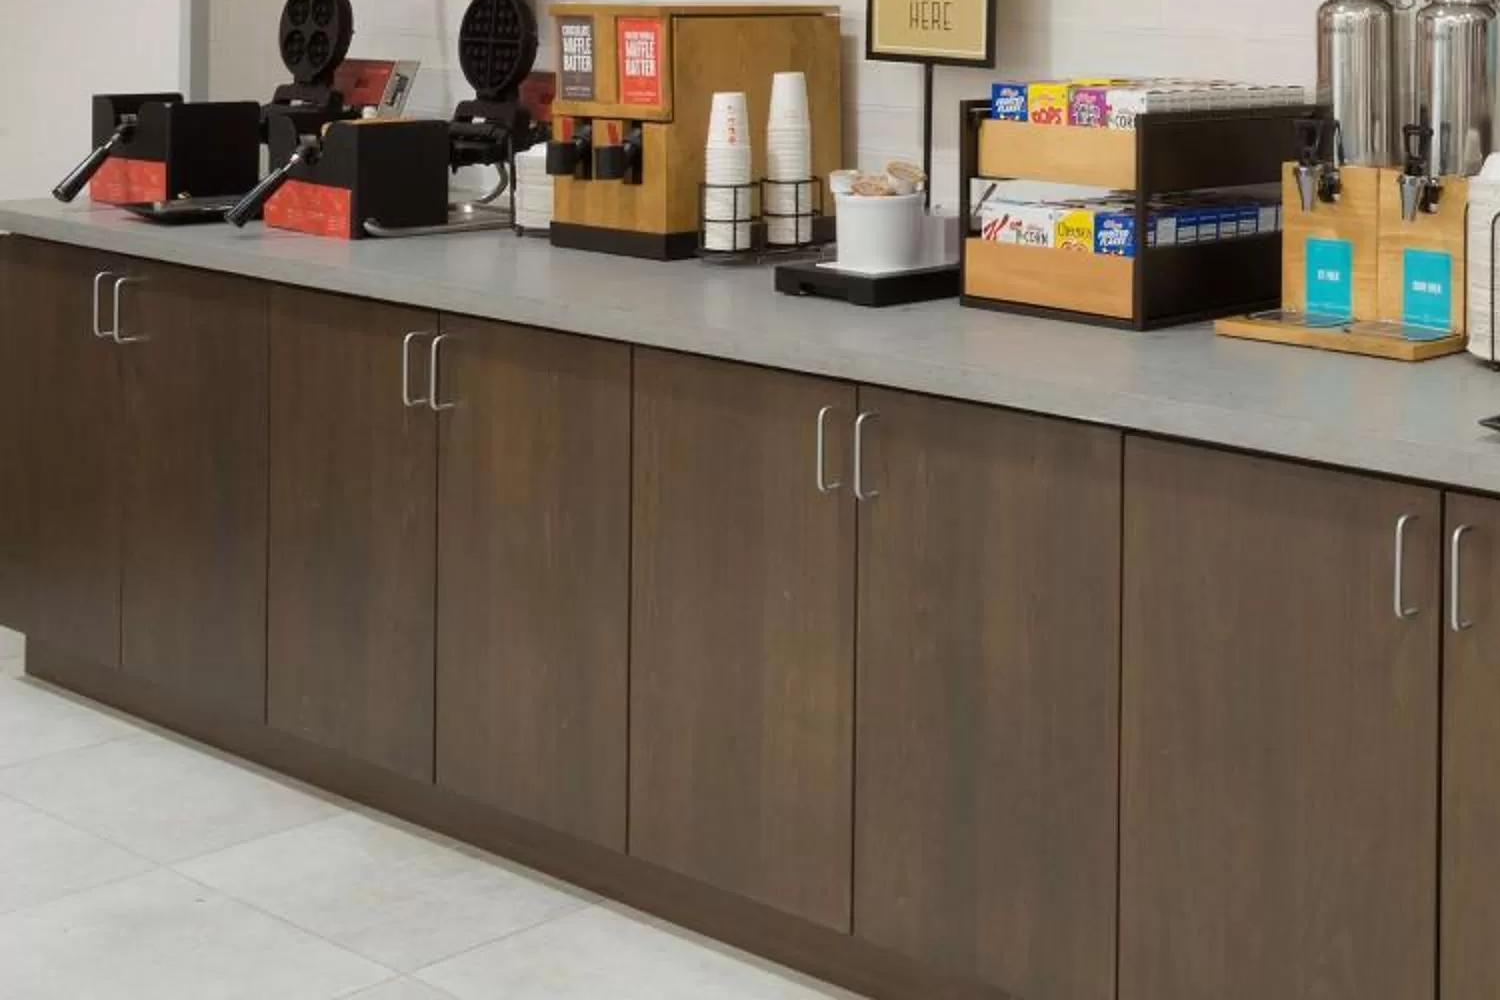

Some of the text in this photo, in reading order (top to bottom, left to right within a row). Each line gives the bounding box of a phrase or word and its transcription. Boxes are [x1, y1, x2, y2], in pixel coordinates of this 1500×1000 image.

[909, 1, 953, 31] HERE
[563, 37, 592, 54] WAFFLE
[625, 41, 657, 58] WAFFLE
[564, 55, 593, 72] BATTER
[625, 59, 657, 77] BATTER
